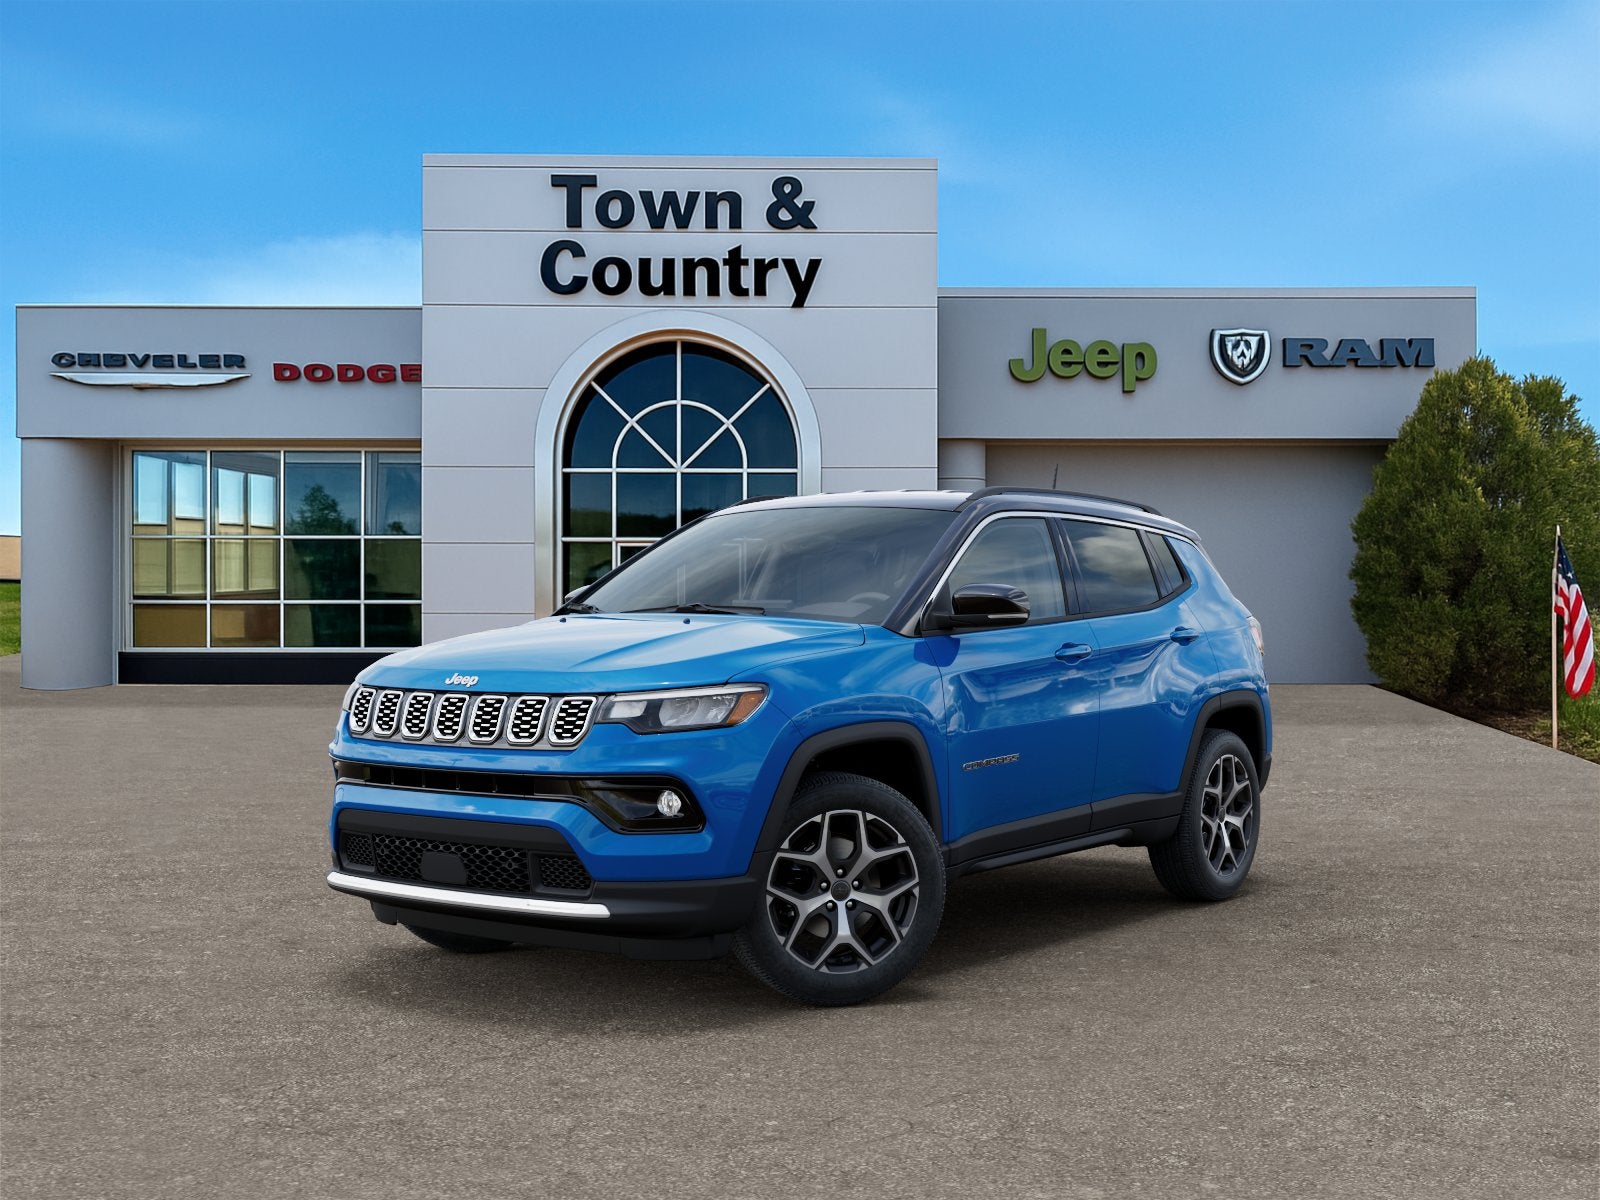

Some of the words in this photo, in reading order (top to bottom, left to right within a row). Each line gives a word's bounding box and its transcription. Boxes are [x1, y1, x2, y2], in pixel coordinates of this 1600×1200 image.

[550, 174, 743, 230] Town
[765, 175, 818, 230] &
[540, 239, 822, 308] Country
[273, 363, 422, 383] DODGE
[1009, 328, 1157, 393] Jeep
[1282, 338, 1436, 367] RAM
[445, 672, 479, 688] Jeep
